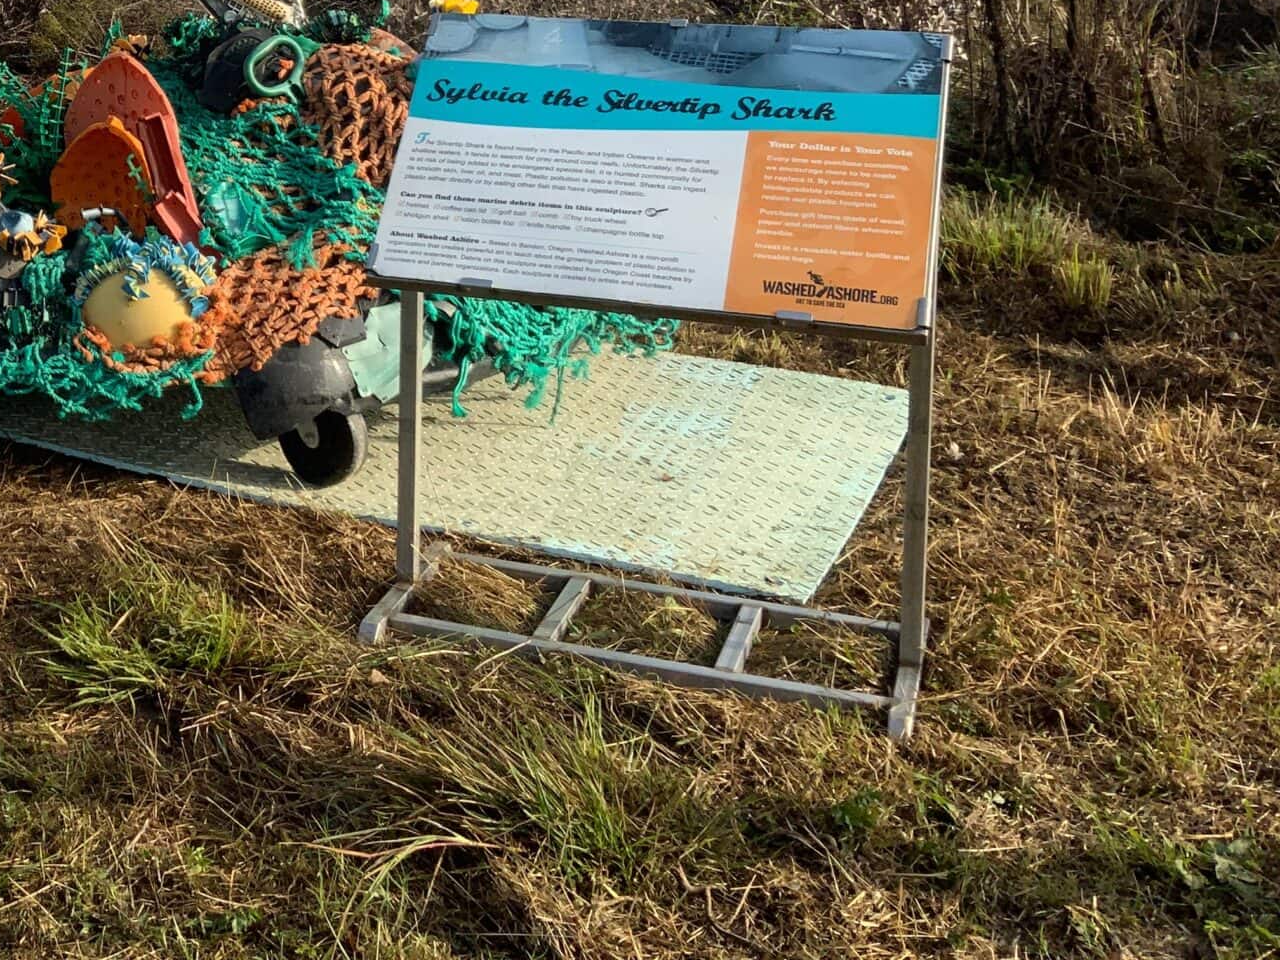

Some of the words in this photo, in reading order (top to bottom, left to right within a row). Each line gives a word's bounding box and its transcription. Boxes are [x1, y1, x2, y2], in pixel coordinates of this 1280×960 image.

[426, 79, 529, 105] Sylvia
[542, 83, 589, 108] the
[597, 89, 721, 120] Silvertip
[731, 96, 838, 121] Shark
[799, 142, 836, 152] Dollar
[477, 197, 508, 205] marine
[509, 200, 536, 208] debris
[538, 202, 562, 210] items
[595, 206, 642, 217] sculpture?
[390, 230, 414, 238] About
[416, 232, 449, 241] Washed
[449, 236, 480, 244] Ashore
[762, 279, 817, 298] WASHED
